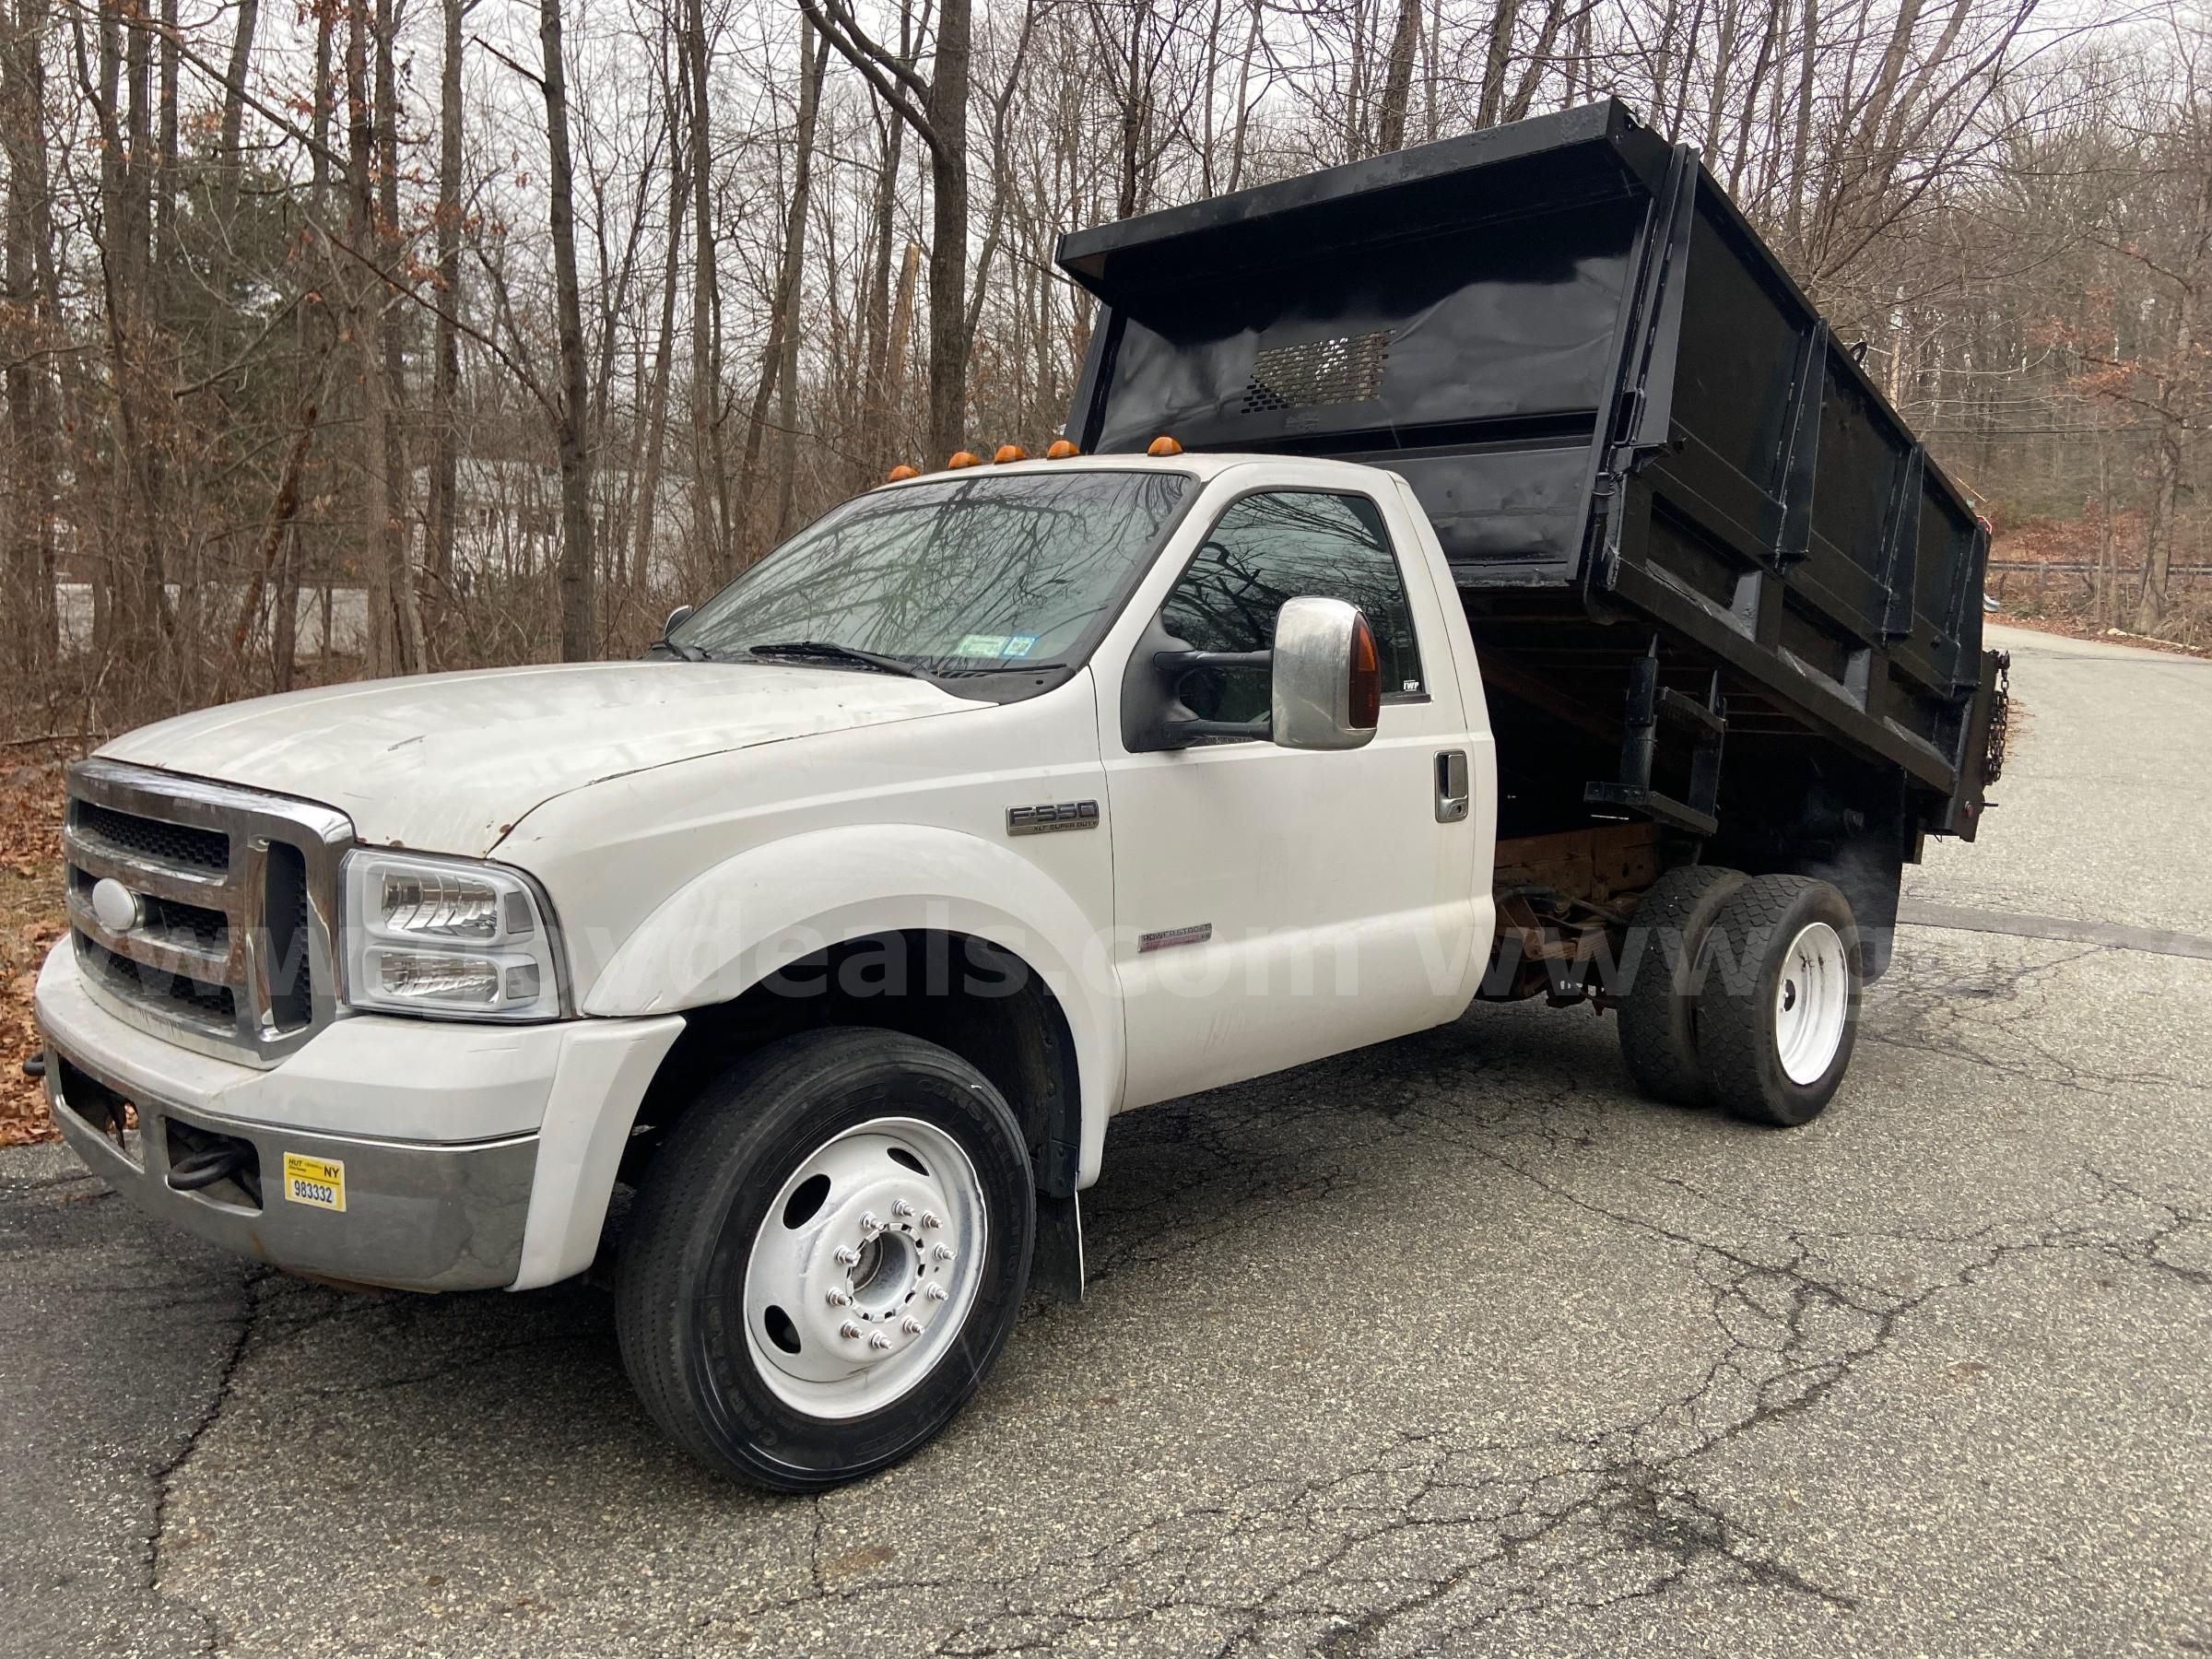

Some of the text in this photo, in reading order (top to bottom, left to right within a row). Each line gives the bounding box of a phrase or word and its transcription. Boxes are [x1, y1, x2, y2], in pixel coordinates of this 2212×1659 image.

[1049, 822, 1075, 830] SUPER
[324, 1166, 340, 1179] NY
[294, 1180, 333, 1204] 983332
